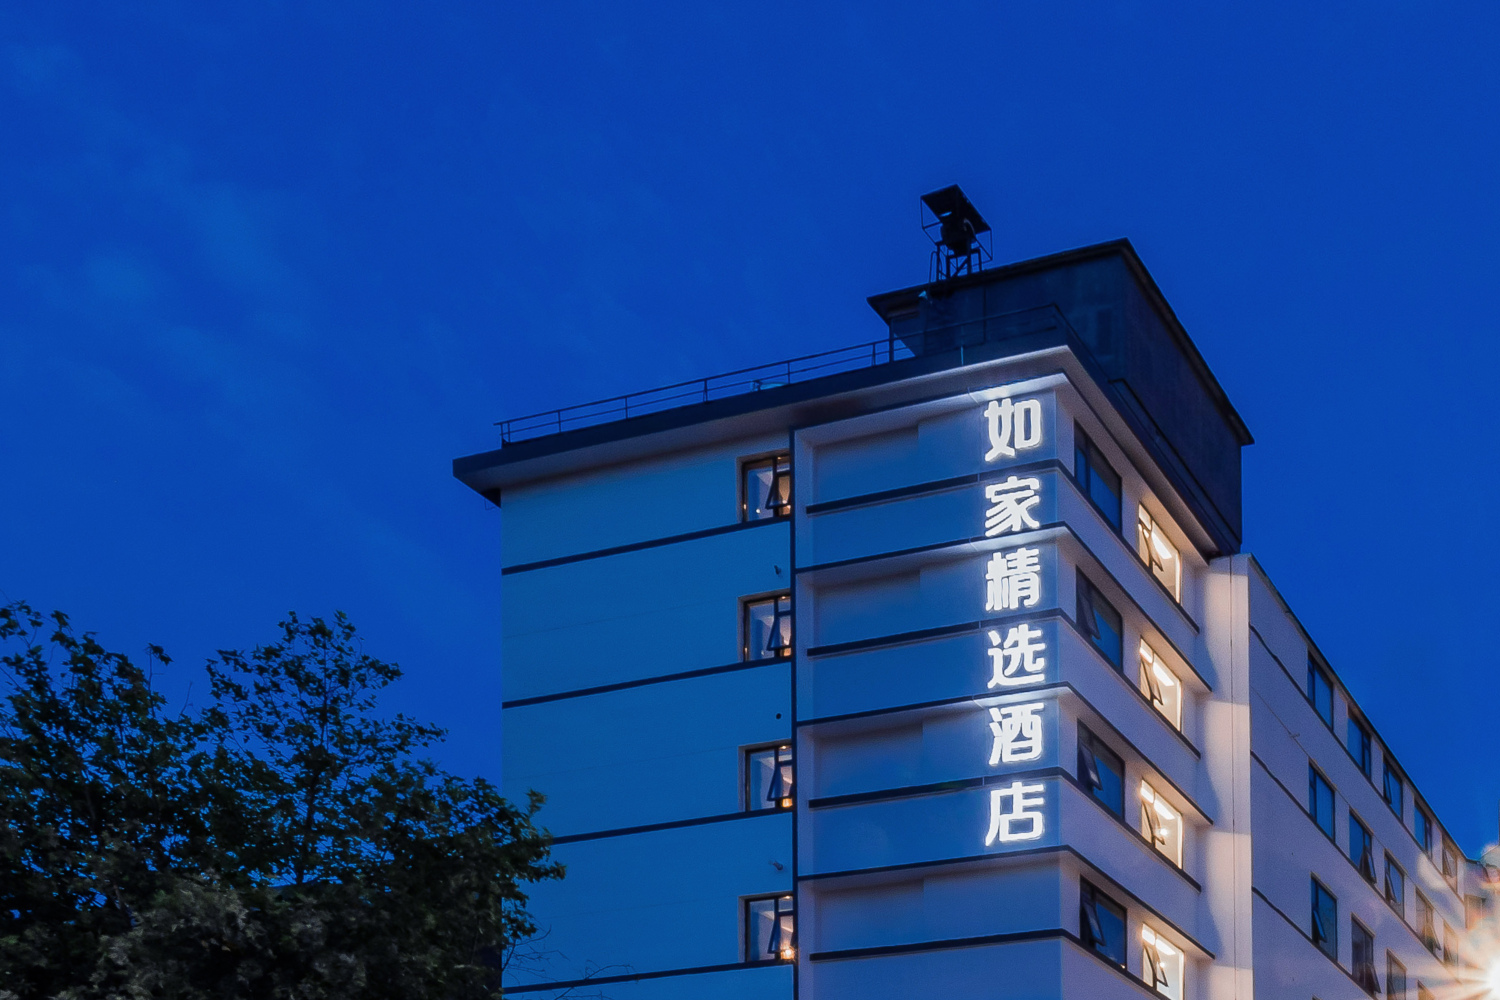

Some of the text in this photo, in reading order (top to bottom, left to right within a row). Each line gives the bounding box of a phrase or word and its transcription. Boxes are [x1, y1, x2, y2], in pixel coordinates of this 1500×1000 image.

[984, 397, 1046, 846] 如家精选酒店
